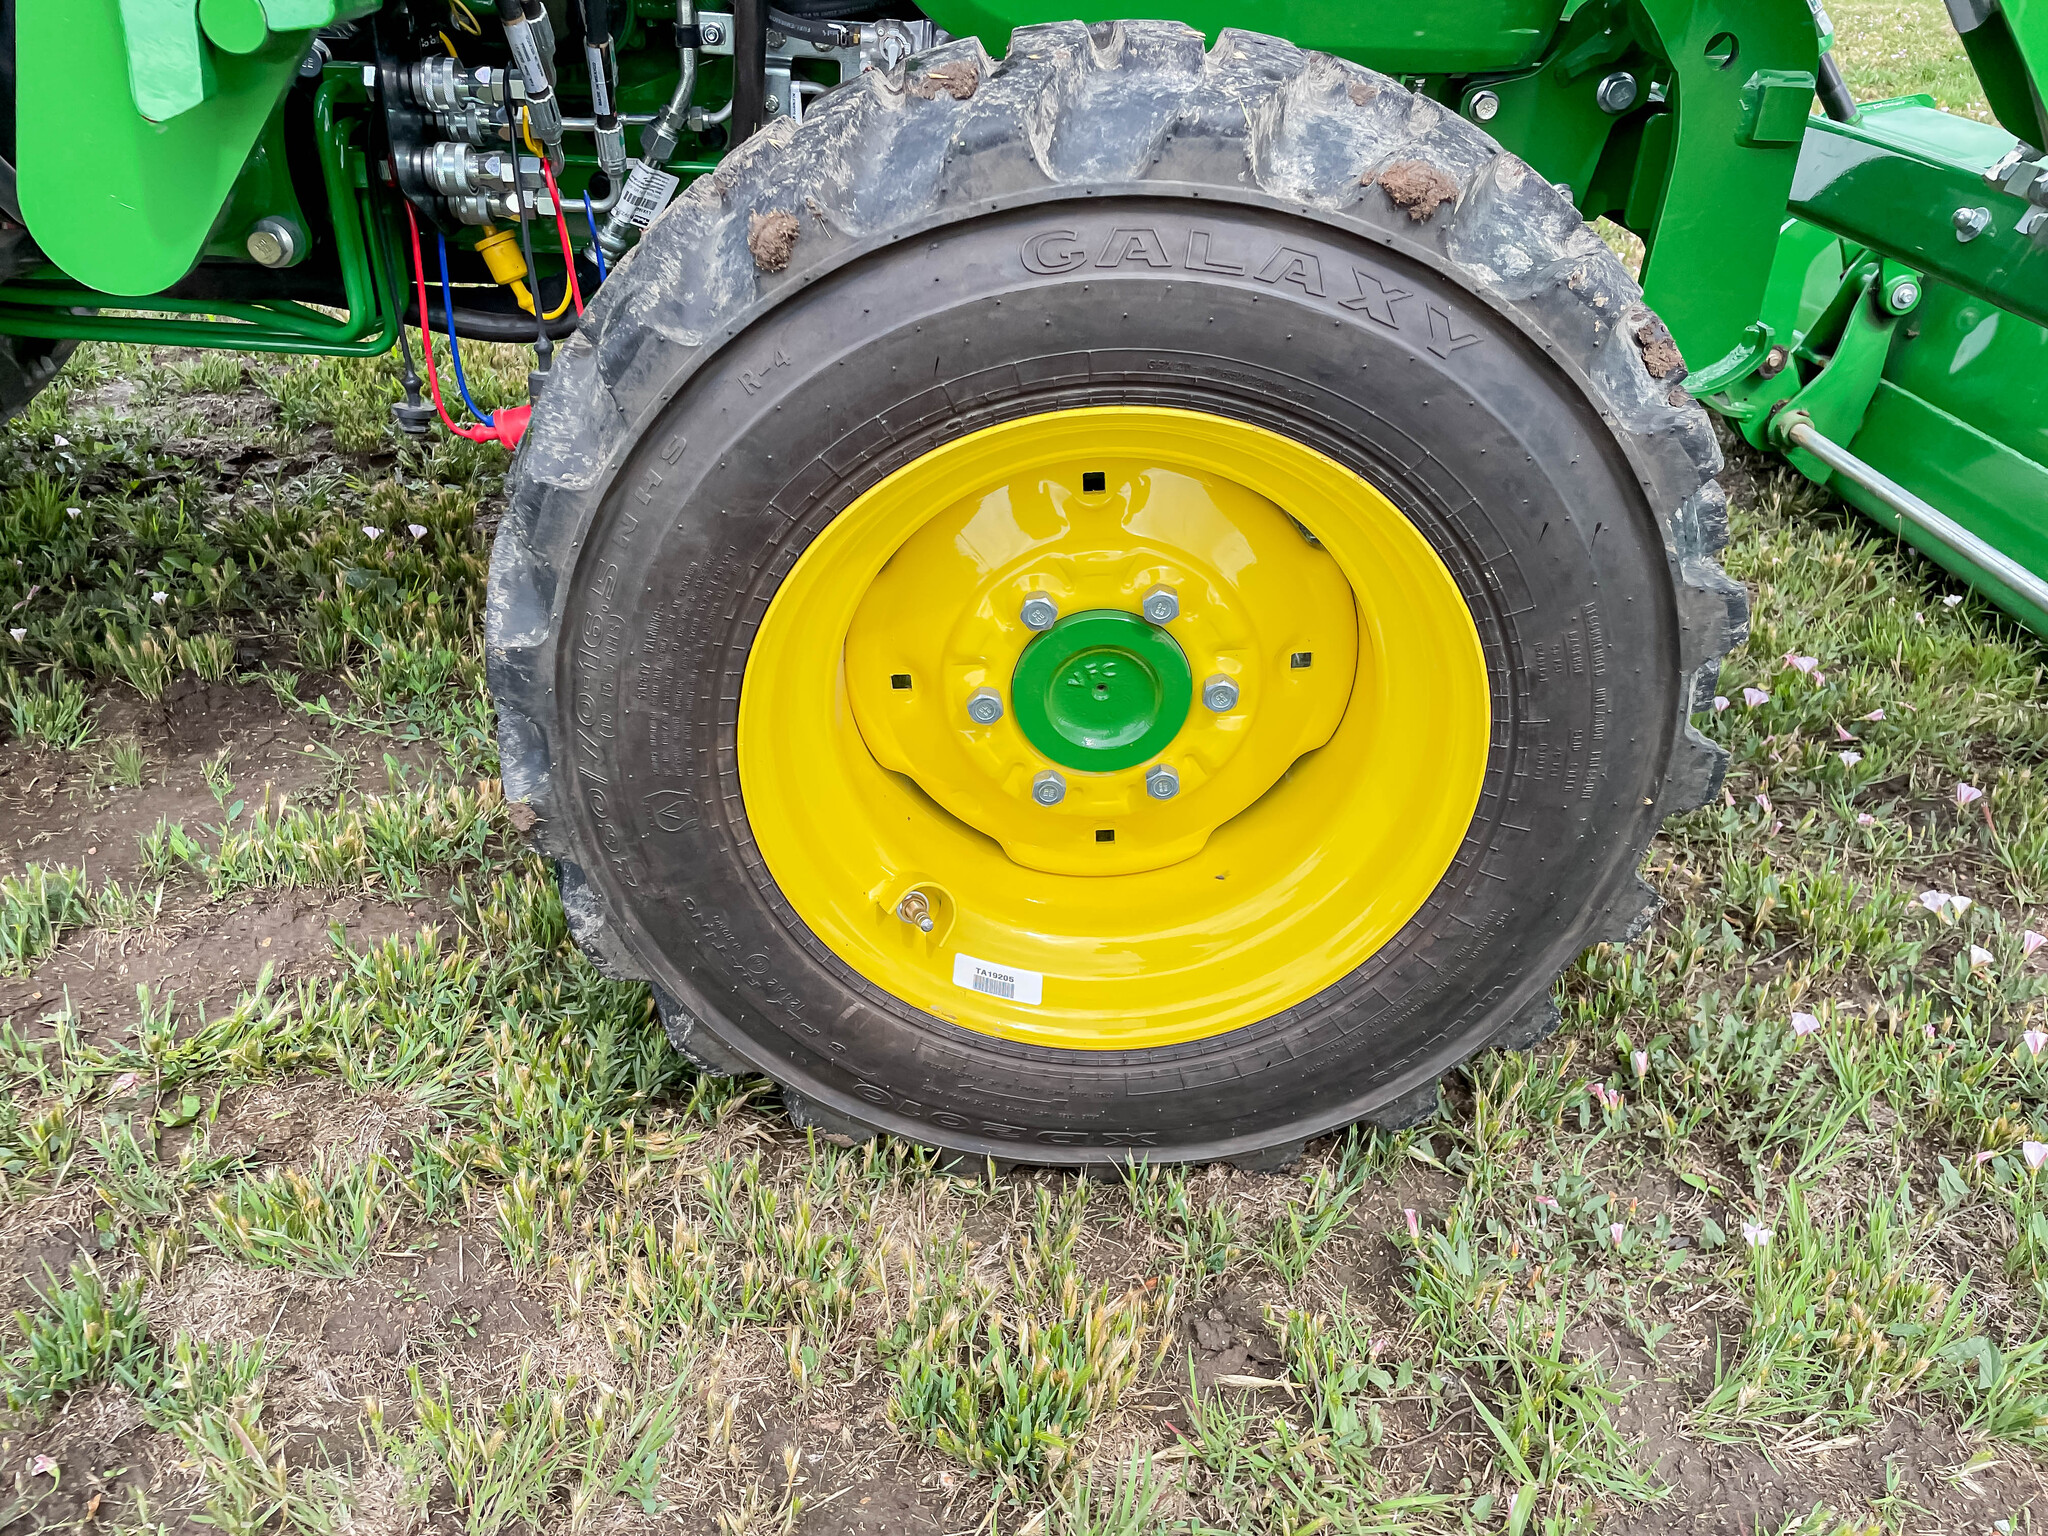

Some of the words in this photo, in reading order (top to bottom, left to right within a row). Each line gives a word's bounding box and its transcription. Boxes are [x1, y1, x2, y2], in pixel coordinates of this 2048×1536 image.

[1020, 227, 1484, 360] GALAXY
[737, 348, 791, 396] R-4
[976, 967, 1015, 983] TA19205
[854, 1082, 1158, 1147] XD2010
